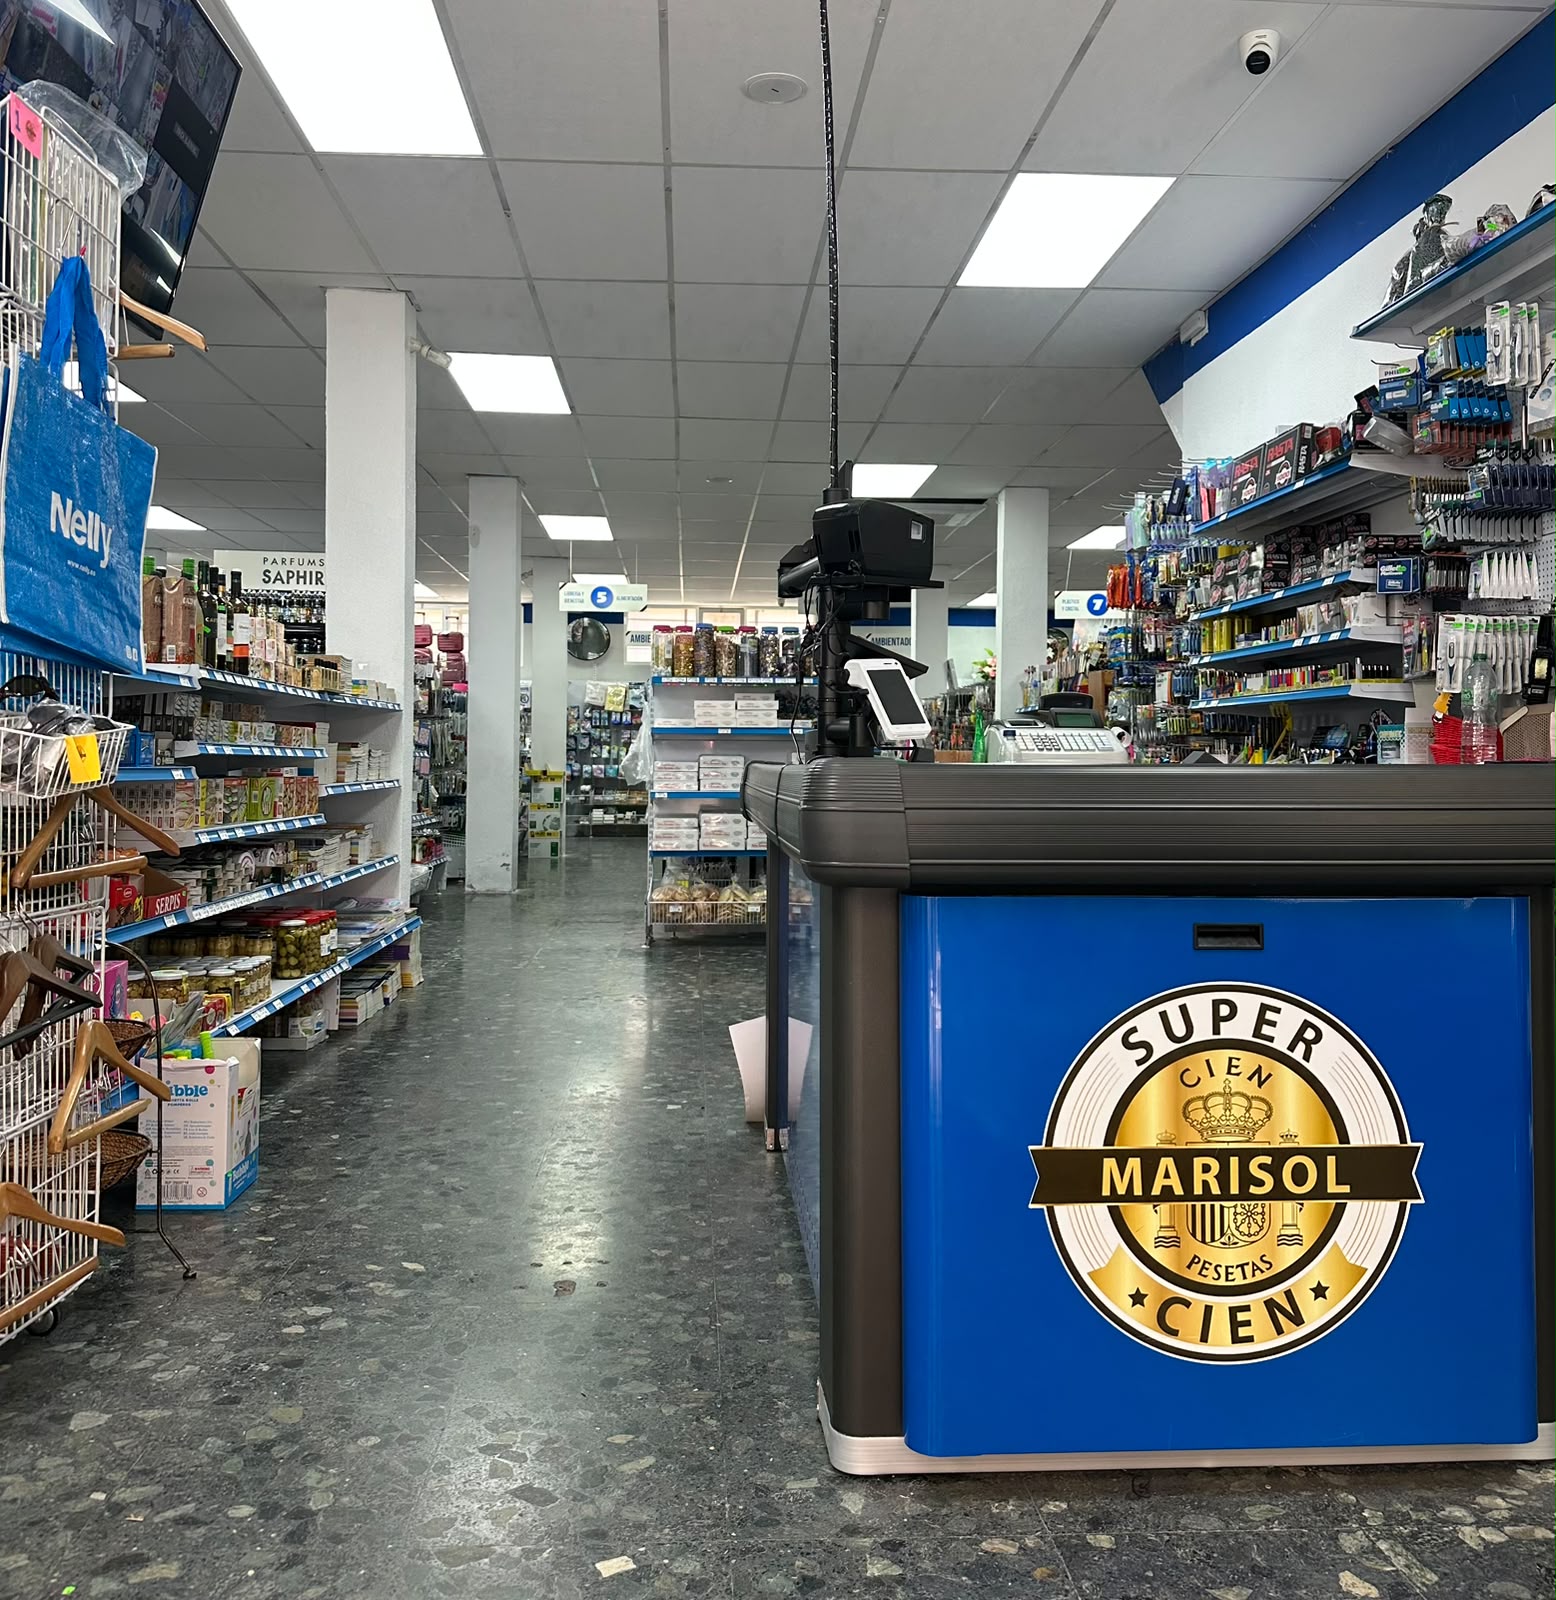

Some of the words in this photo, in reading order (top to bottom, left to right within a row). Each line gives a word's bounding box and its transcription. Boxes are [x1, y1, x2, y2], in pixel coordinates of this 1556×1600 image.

[1267, 438, 1293, 461] RASTA
[1298, 444, 1308, 474] RASTA
[50, 490, 113, 568] Nelly
[263, 556, 325, 567] PARFUMS
[262, 569, 325, 586] SAPHIR
[596, 591, 608, 604] 5
[1092, 598, 1104, 611] 7
[155, 892, 181, 915] SERPIS
[1121, 998, 1323, 1066] SUPER
[1179, 1057, 1273, 1088] CIEN
[1101, 1155, 1350, 1196] MARISOL
[1186, 1254, 1273, 1282] PESETAS
[1156, 1288, 1306, 1344] CIEN
